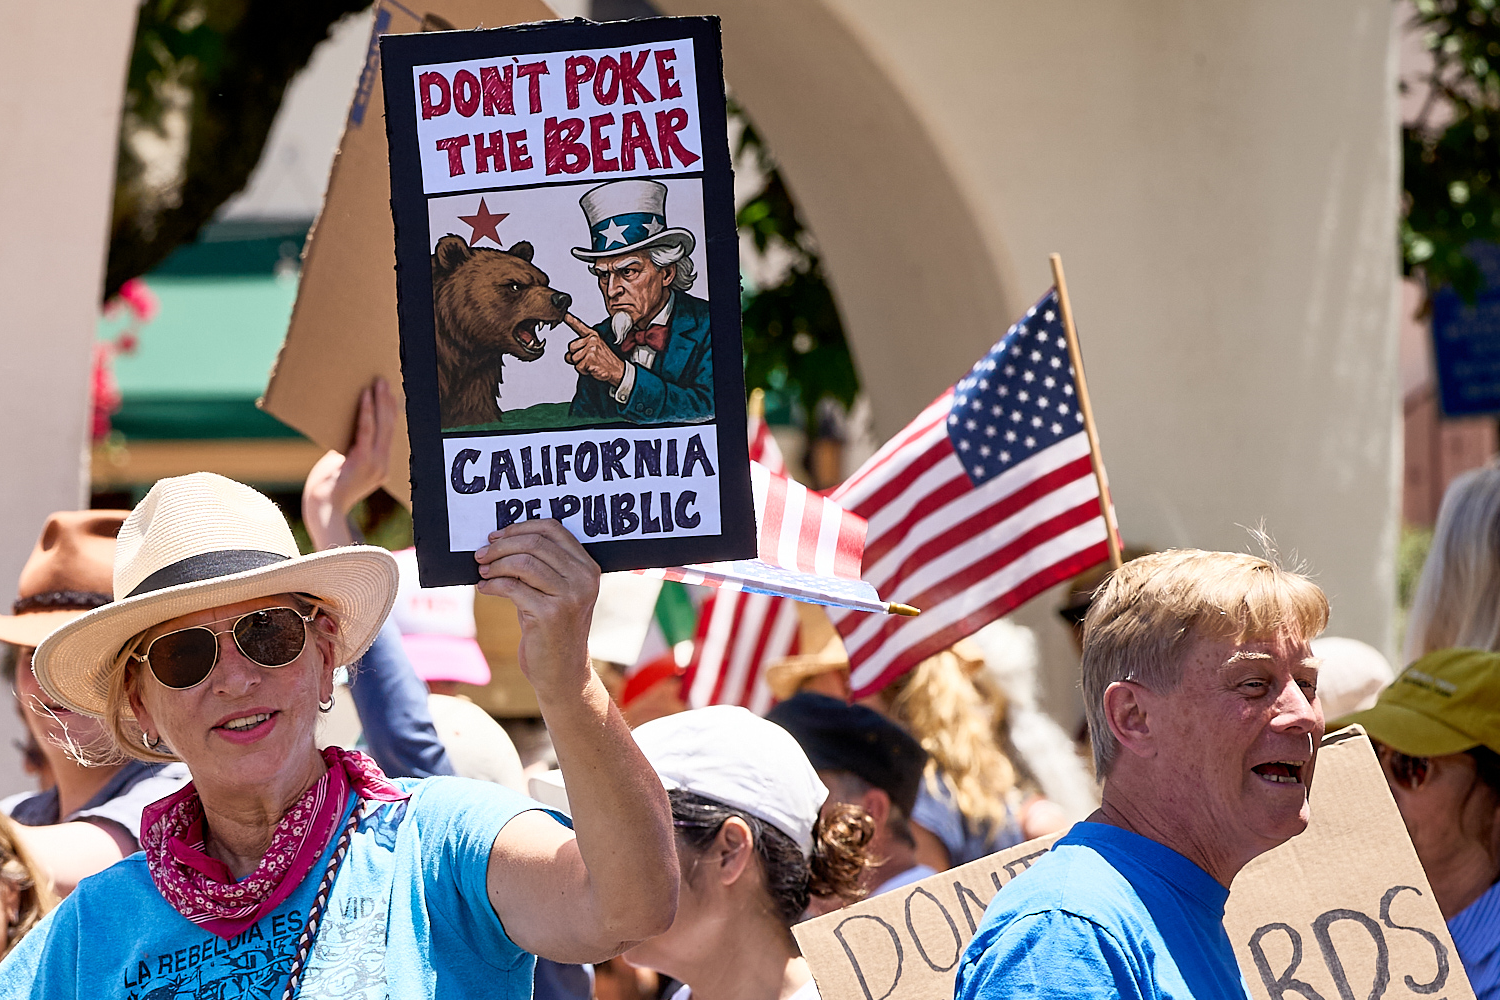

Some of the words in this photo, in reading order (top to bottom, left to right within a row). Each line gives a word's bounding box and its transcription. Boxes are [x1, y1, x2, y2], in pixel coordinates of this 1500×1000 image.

[419, 57, 550, 120] DON'T
[566, 48, 683, 111] POKE
[436, 129, 533, 178] THE
[544, 107, 701, 176] BEAR
[451, 433, 716, 494] CALIFORNIA
[495, 490, 701, 537] REPUBLIC
[124, 960, 151, 989] LA
[272, 910, 303, 937] ES
[339, 897, 386, 919] VID
